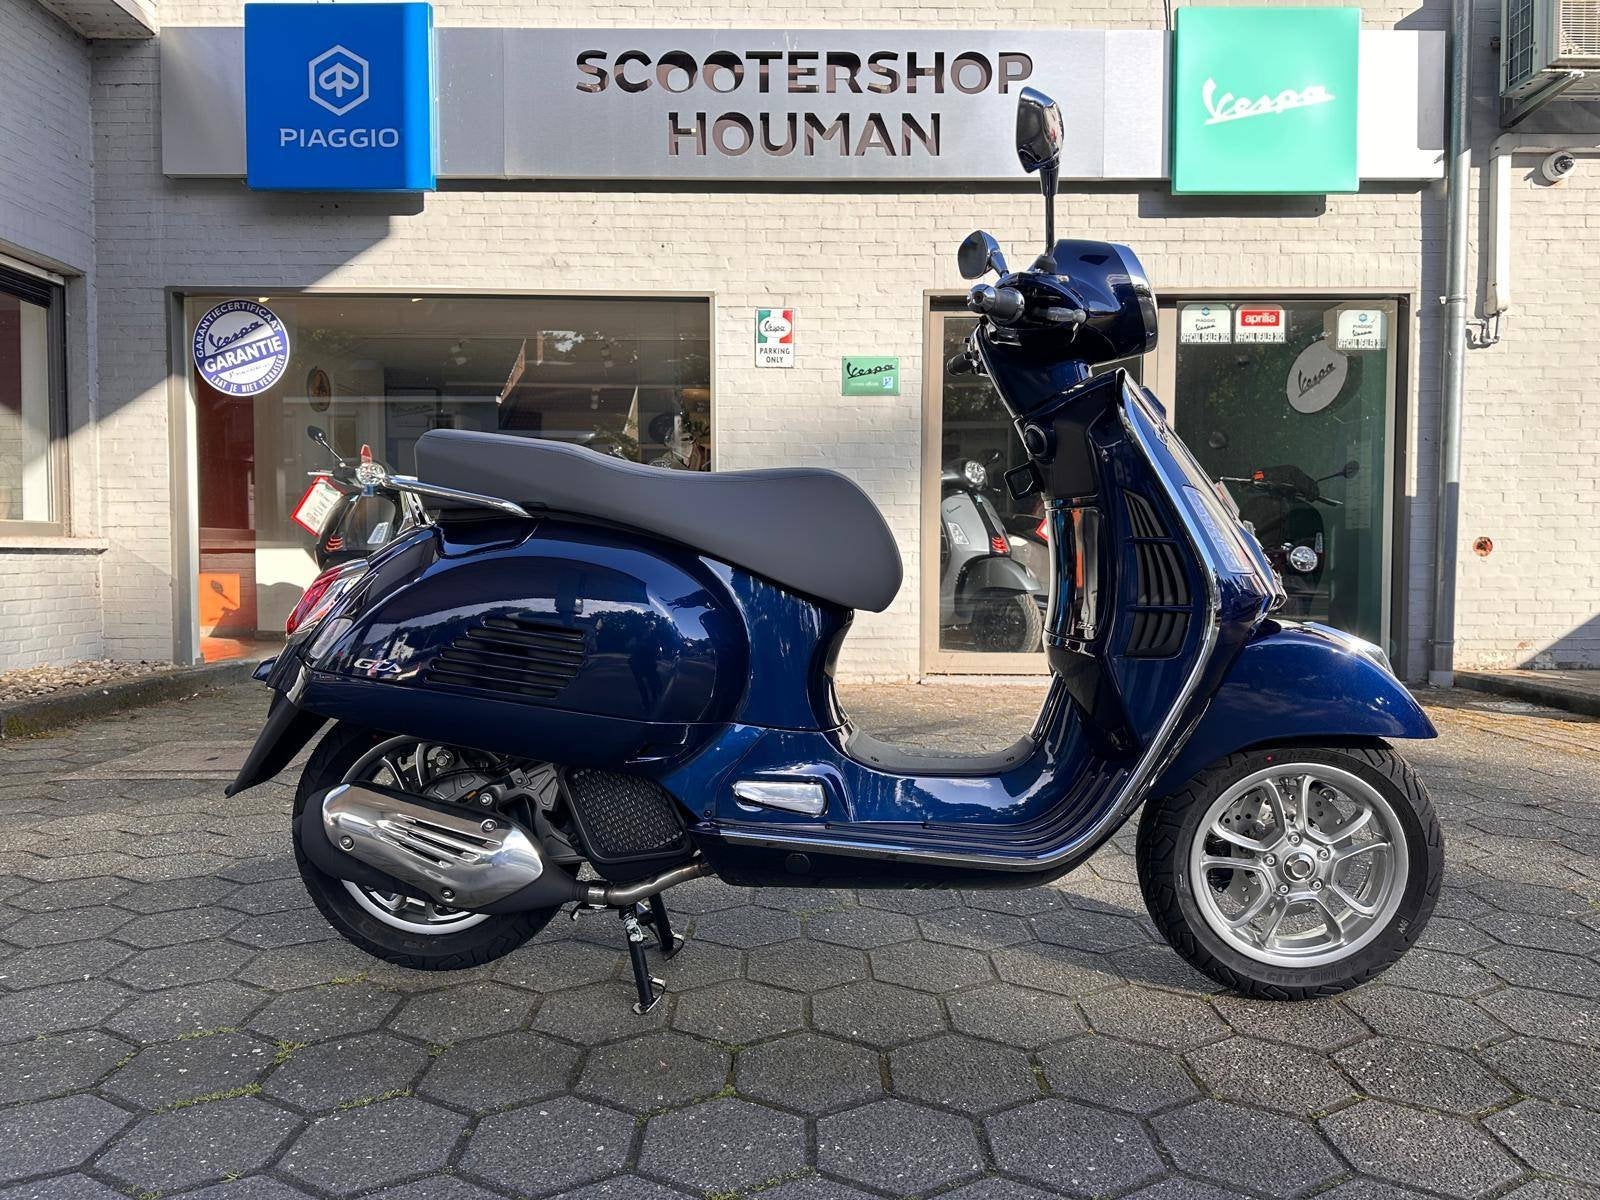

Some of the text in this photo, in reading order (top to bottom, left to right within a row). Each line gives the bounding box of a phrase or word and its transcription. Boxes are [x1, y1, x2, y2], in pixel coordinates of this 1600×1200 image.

[575, 49, 1034, 95] SCOOTERSHOP
[1201, 77, 1336, 126] Vespa
[279, 127, 399, 148] PIAGGIO
[667, 111, 941, 157] HOUMAN
[196, 302, 282, 358] GARANTIECERTIFICAAT
[208, 321, 264, 352] Vespa
[764, 320, 786, 332] Vespa
[204, 336, 283, 373] GARANTIE
[759, 347, 790, 355] PARKING
[211, 375, 228, 389] LAAT
[229, 384, 238, 393] JE
[241, 383, 259, 393] NIET
[259, 354, 286, 387] VERRASSEN
[846, 362, 895, 379] Vespa
[1297, 362, 1336, 398] Vespa
